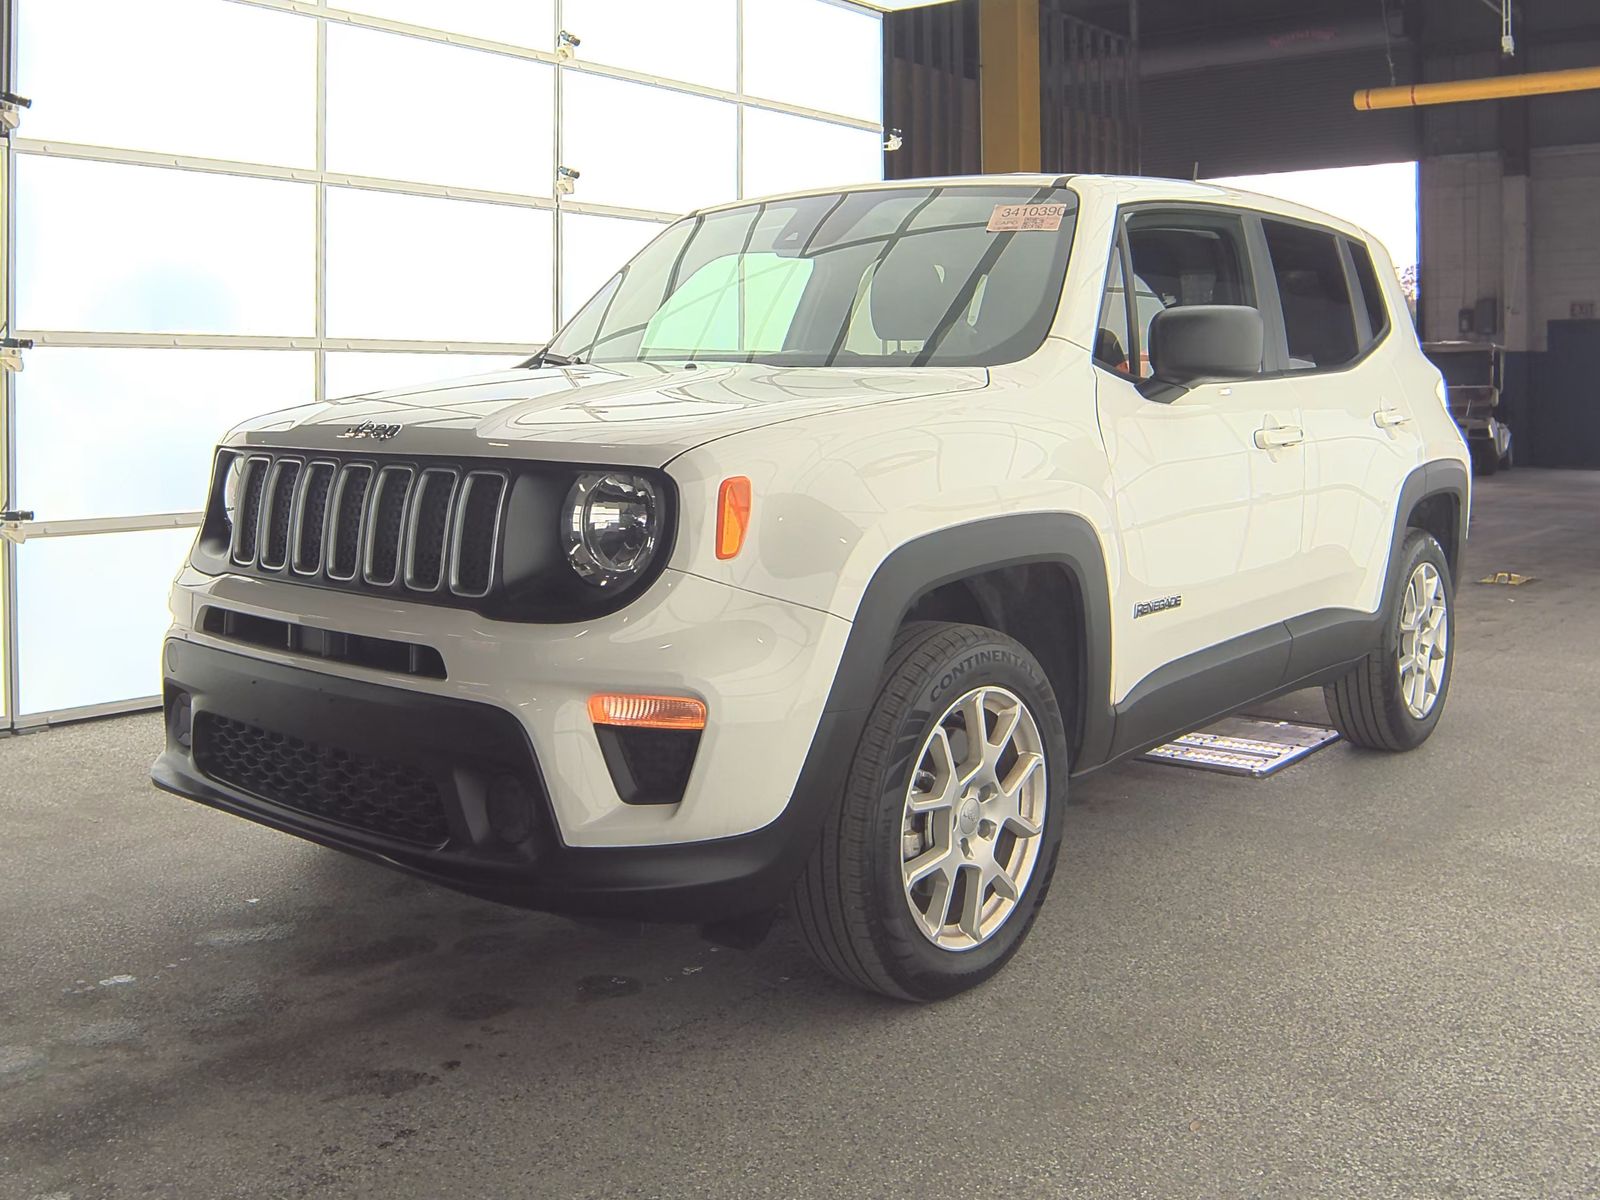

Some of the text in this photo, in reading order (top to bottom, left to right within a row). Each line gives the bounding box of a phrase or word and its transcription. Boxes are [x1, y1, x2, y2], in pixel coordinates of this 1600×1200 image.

[341, 420, 402, 441] Jeep
[1133, 595, 1182, 619] RENEGADE
[930, 650, 1036, 702] CONTINENTAL
